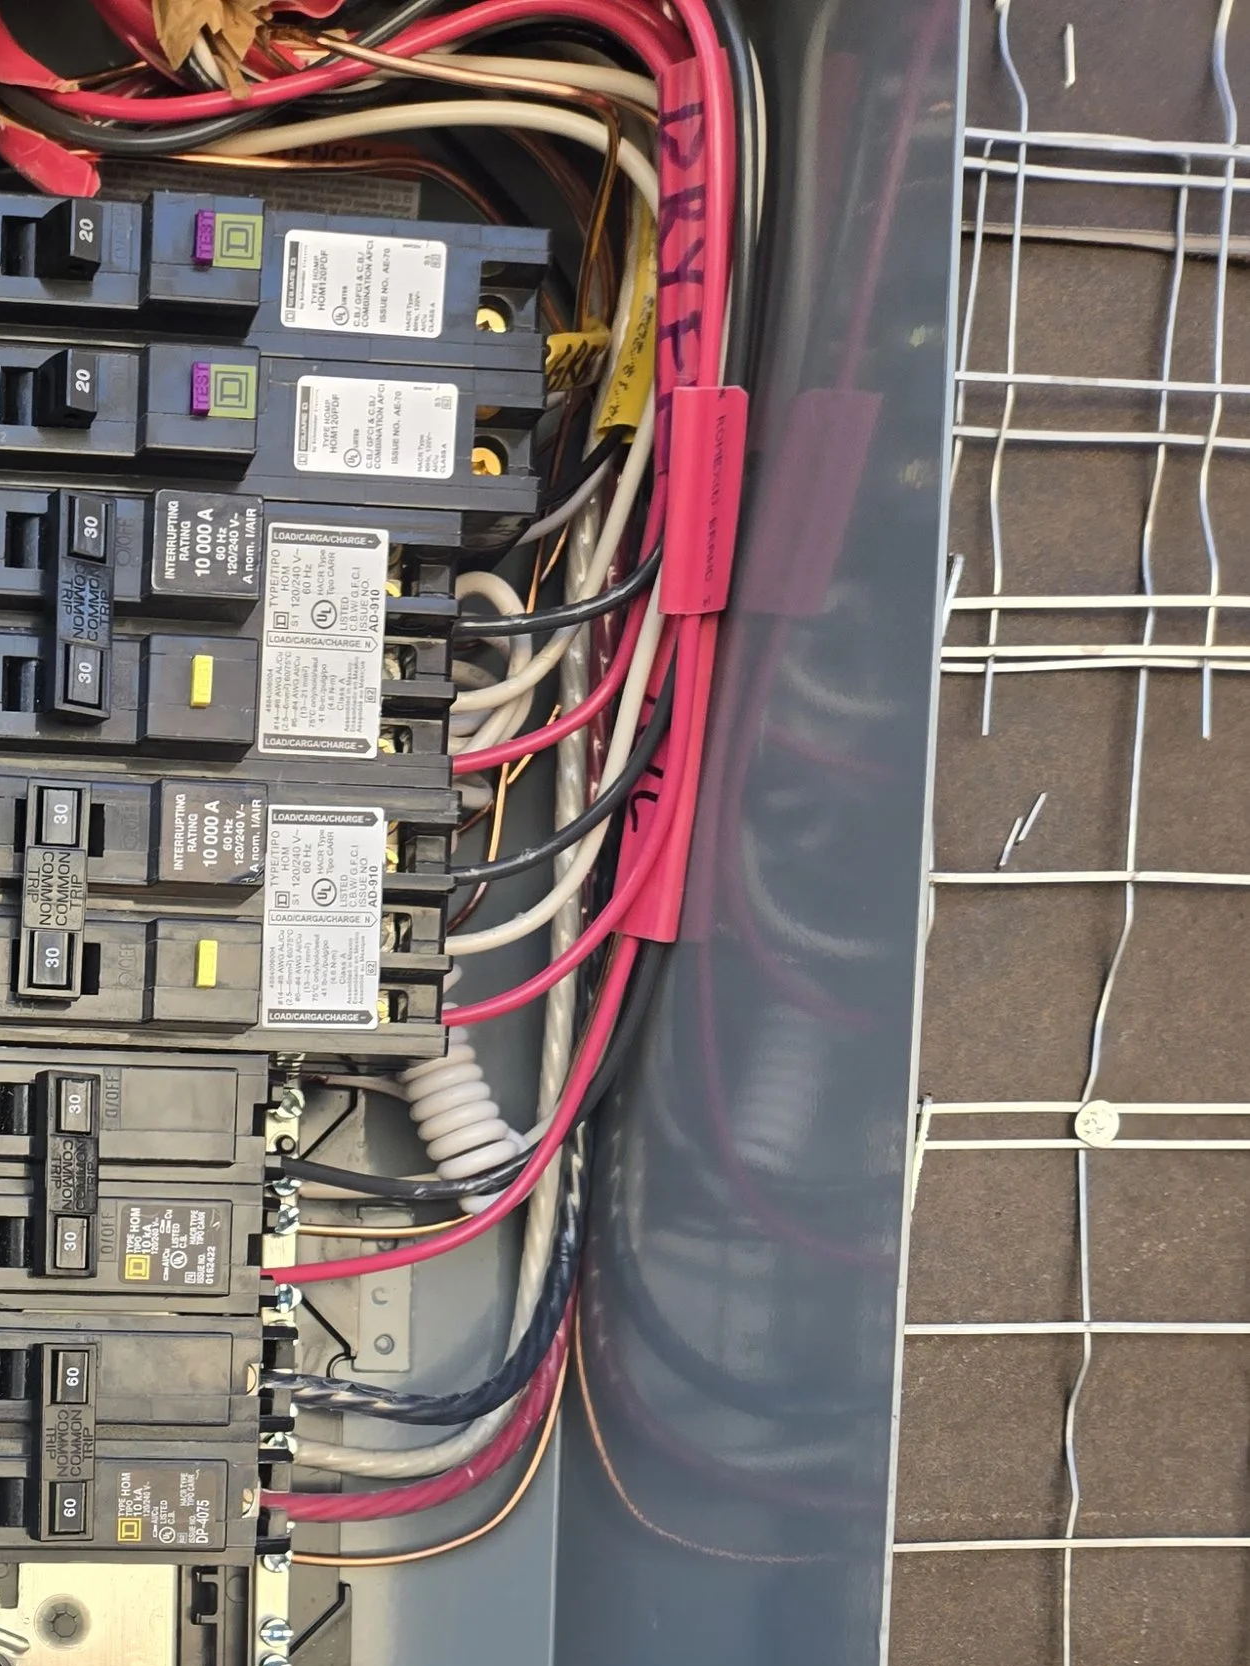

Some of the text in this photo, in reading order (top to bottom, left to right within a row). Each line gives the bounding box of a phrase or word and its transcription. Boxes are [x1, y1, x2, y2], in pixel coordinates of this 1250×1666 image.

[79, 218, 94, 243] 20
[318, 250, 327, 311] HOM120PDF
[361, 264, 372, 328] COMBINATION
[379, 248, 391, 324] ISSUE AE-70
[76, 369, 91, 394] 20
[82, 515, 98, 540] 30
[165, 501, 179, 580] INTERRUPTING
[179, 521, 191, 561] RATING
[216, 527, 227, 560] 60 Hz
[273, 532, 367, 546] LOAD/CARGA/CHARGE
[194, 523, 212, 577] 10 000
[227, 528, 240, 576] 120/240
[244, 544, 254, 572] nom.
[269, 549, 280, 608] TYPE/TIPO
[281, 566, 290, 591] HOM
[291, 567, 301, 608] 120/240
[302, 564, 312, 594] 60 Hz
[339, 596, 349, 631] LISTED
[359, 600, 369, 632] ISSUE
[369, 589, 380, 633] AD-910
[78, 662, 92, 684] 30
[54, 804, 68, 824] 30
[273, 813, 364, 823] LOAD/CARGA/CHARGE
[174, 793, 186, 871] INTERRUPTING
[187, 813, 198, 853] RATING
[203, 815, 219, 868] 10 000
[223, 818, 233, 851] 60 Hz
[234, 820, 246, 865] 120/240
[251, 830, 260, 861] nom.
[270, 830, 281, 886] TYPE/TIPO
[282, 847, 290, 871] HOM
[292, 842, 302, 889] 120/240
[302, 844, 312, 874] 60 Hz
[27, 868, 40, 904] TRIP
[39, 851, 54, 926] COMMON
[55, 852, 71, 926] COMMON
[70, 874, 83, 910] TRIP
[340, 874, 348, 908] LISTED
[358, 877, 367, 908] ISSUE
[368, 865, 379, 908] AD-910
[271, 914, 360, 923] LOAD/CARGA/CHARGE
[45, 947, 60, 968] 30
[270, 1011, 359, 1021] LOAD/CARGA/CHARGE
[69, 1094, 81, 1114] 30
[51, 1155, 62, 1189] TRIP
[62, 1140, 73, 1210] COMMON
[64, 1232, 77, 1251] 30
[126, 1208, 141, 1254] TYPE HOM
[142, 1241, 151, 1254] 10
[171, 1223, 180, 1248] LISTED
[205, 1246, 216, 1284] 0162422
[66, 1367, 79, 1386] 60
[57, 1409, 69, 1477] COMMON
[70, 1409, 82, 1477] COMMON
[82, 1427, 93, 1462] TRIP
[64, 1498, 77, 1517] 60
[118, 1473, 131, 1516] TYPE HOM
[133, 1504, 142, 1516] 10
[195, 1500, 210, 1544] DP-4075
